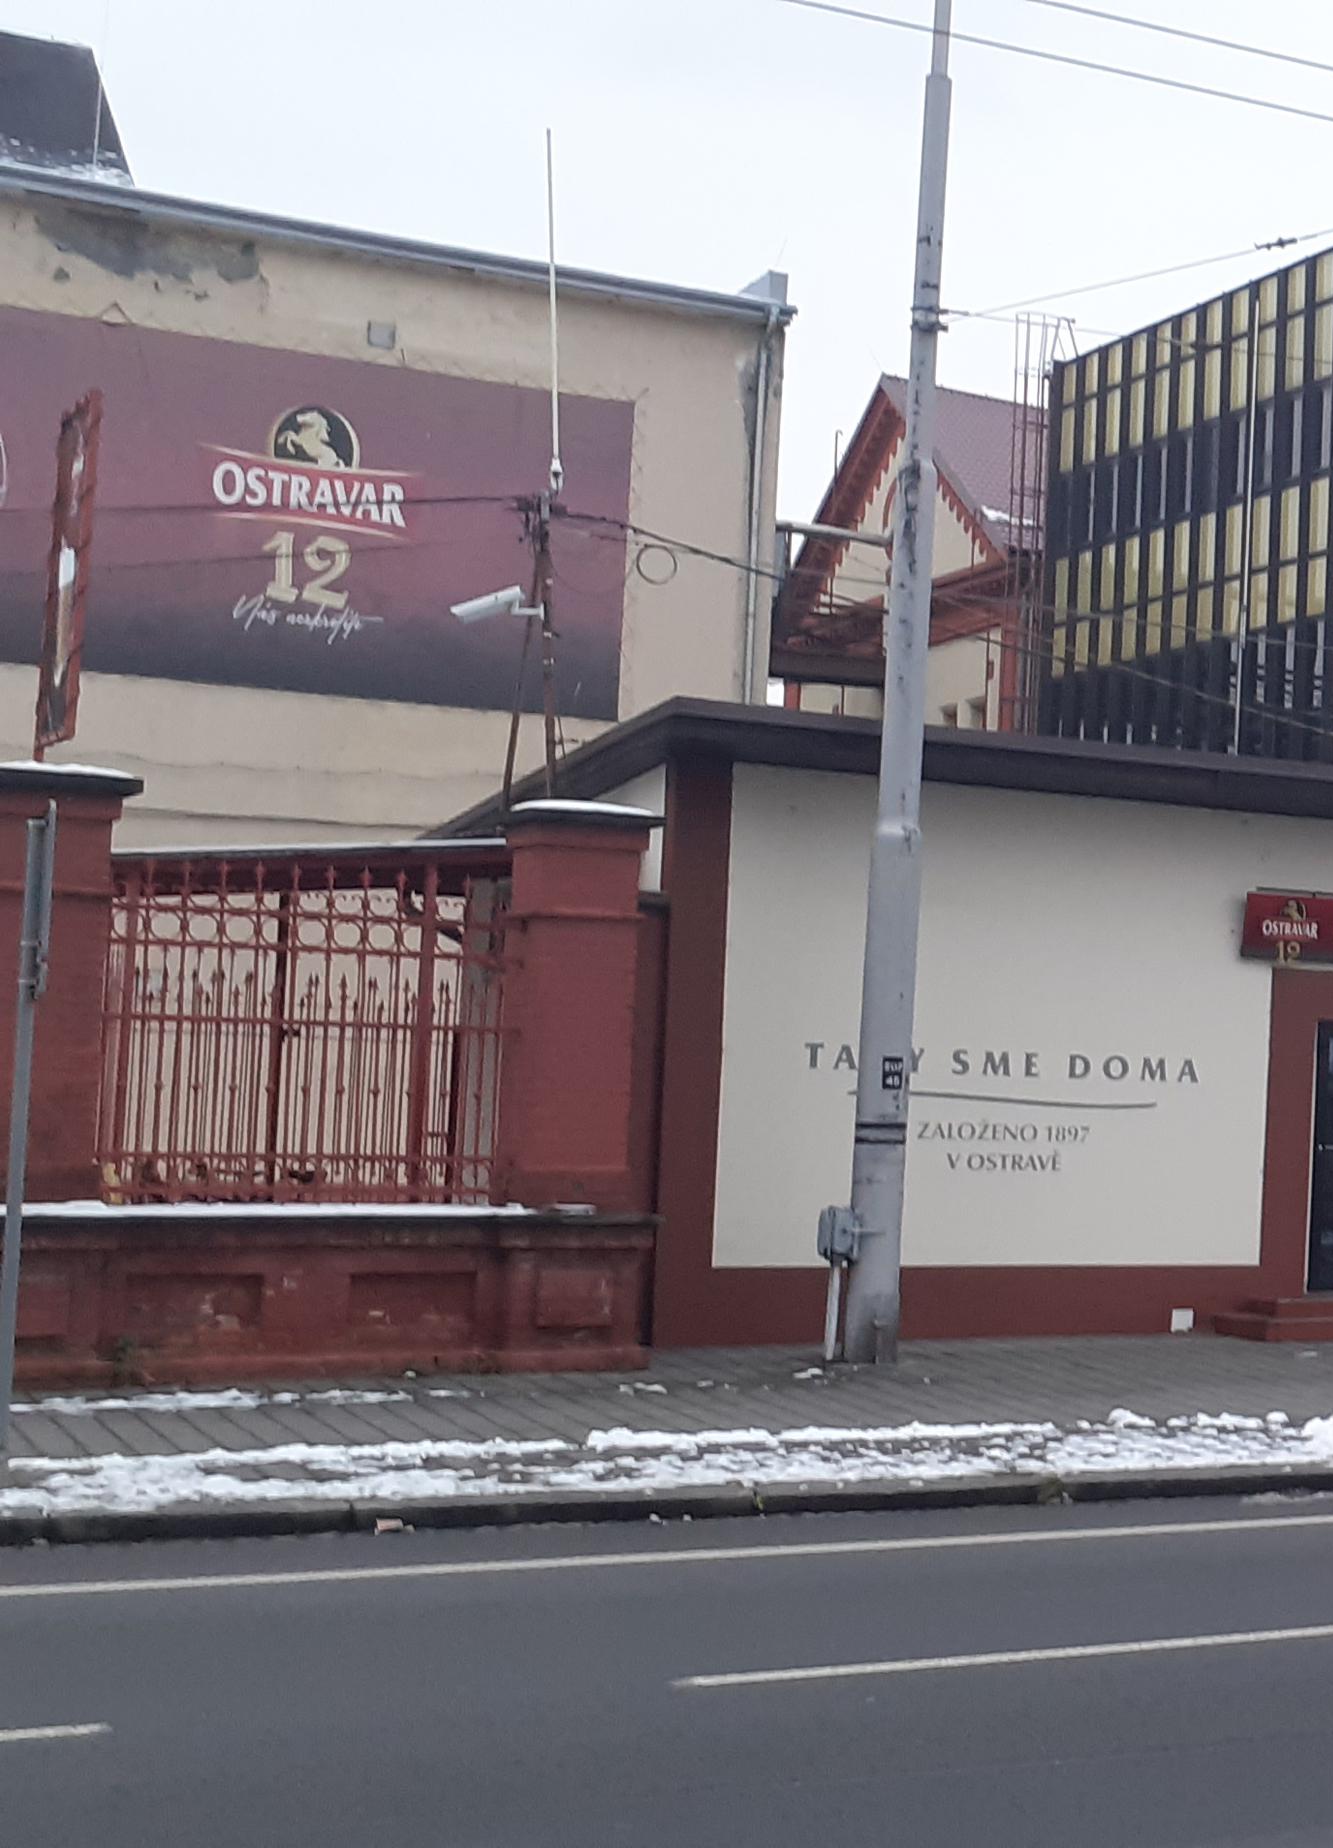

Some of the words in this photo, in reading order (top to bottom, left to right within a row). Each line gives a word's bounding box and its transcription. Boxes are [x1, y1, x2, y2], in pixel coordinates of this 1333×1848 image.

[212, 460, 406, 528] OSTRAVAR
[261, 530, 352, 609] 12
[1262, 918, 1318, 940] OSTRAVAR
[805, 1042, 925, 1074] TAY
[951, 1048, 1040, 1078] SME
[1067, 1053, 1200, 1084] DOMA
[917, 1118, 1039, 1144] ZALOŽENO
[1046, 1125, 1090, 1145] 1897
[947, 1152, 960, 1171] V
[966, 1148, 1063, 1173] OSTRAVĚ
